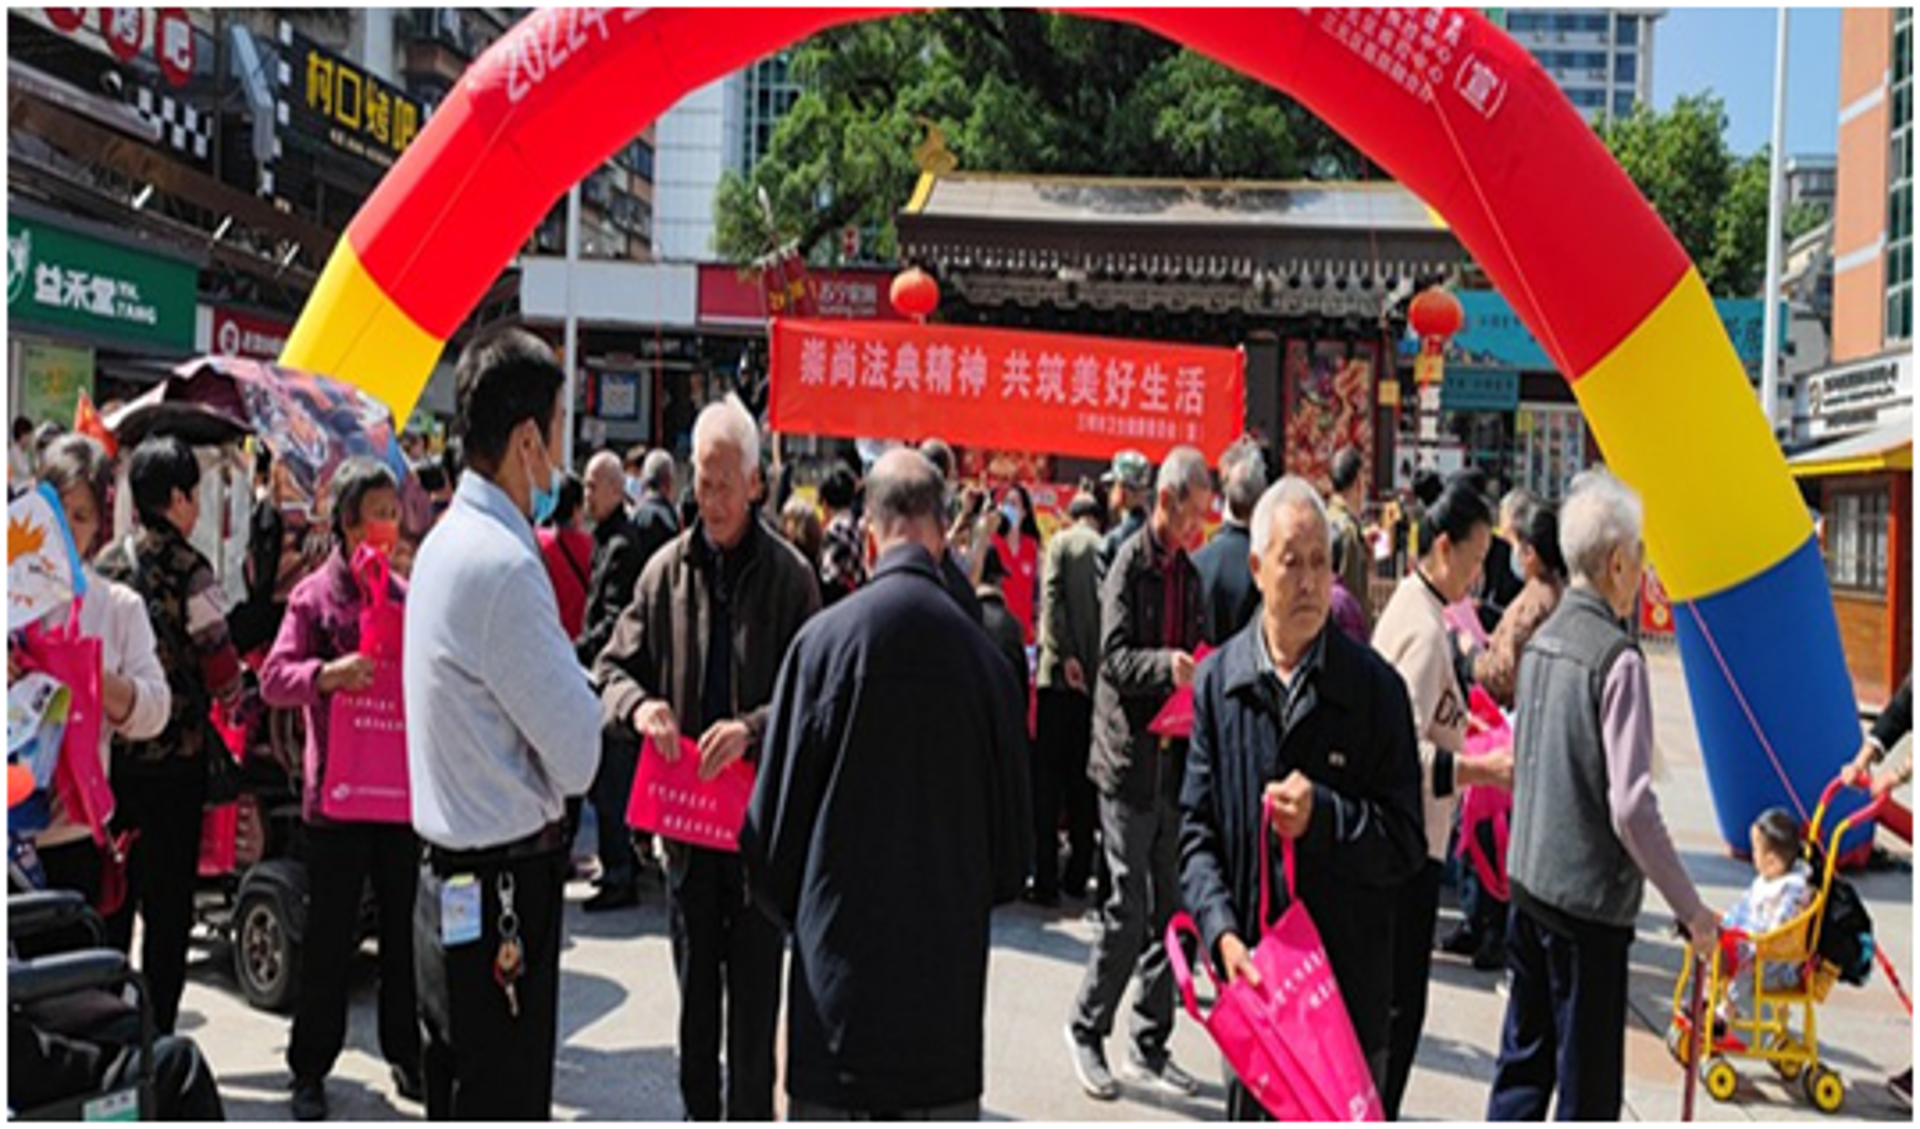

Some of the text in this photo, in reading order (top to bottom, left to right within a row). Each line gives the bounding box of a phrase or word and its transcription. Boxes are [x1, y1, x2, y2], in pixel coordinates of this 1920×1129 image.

[36, 261, 115, 317] 益禾堂
[800, 336, 1206, 414] 崇尚法典精神 共筑美好生活
